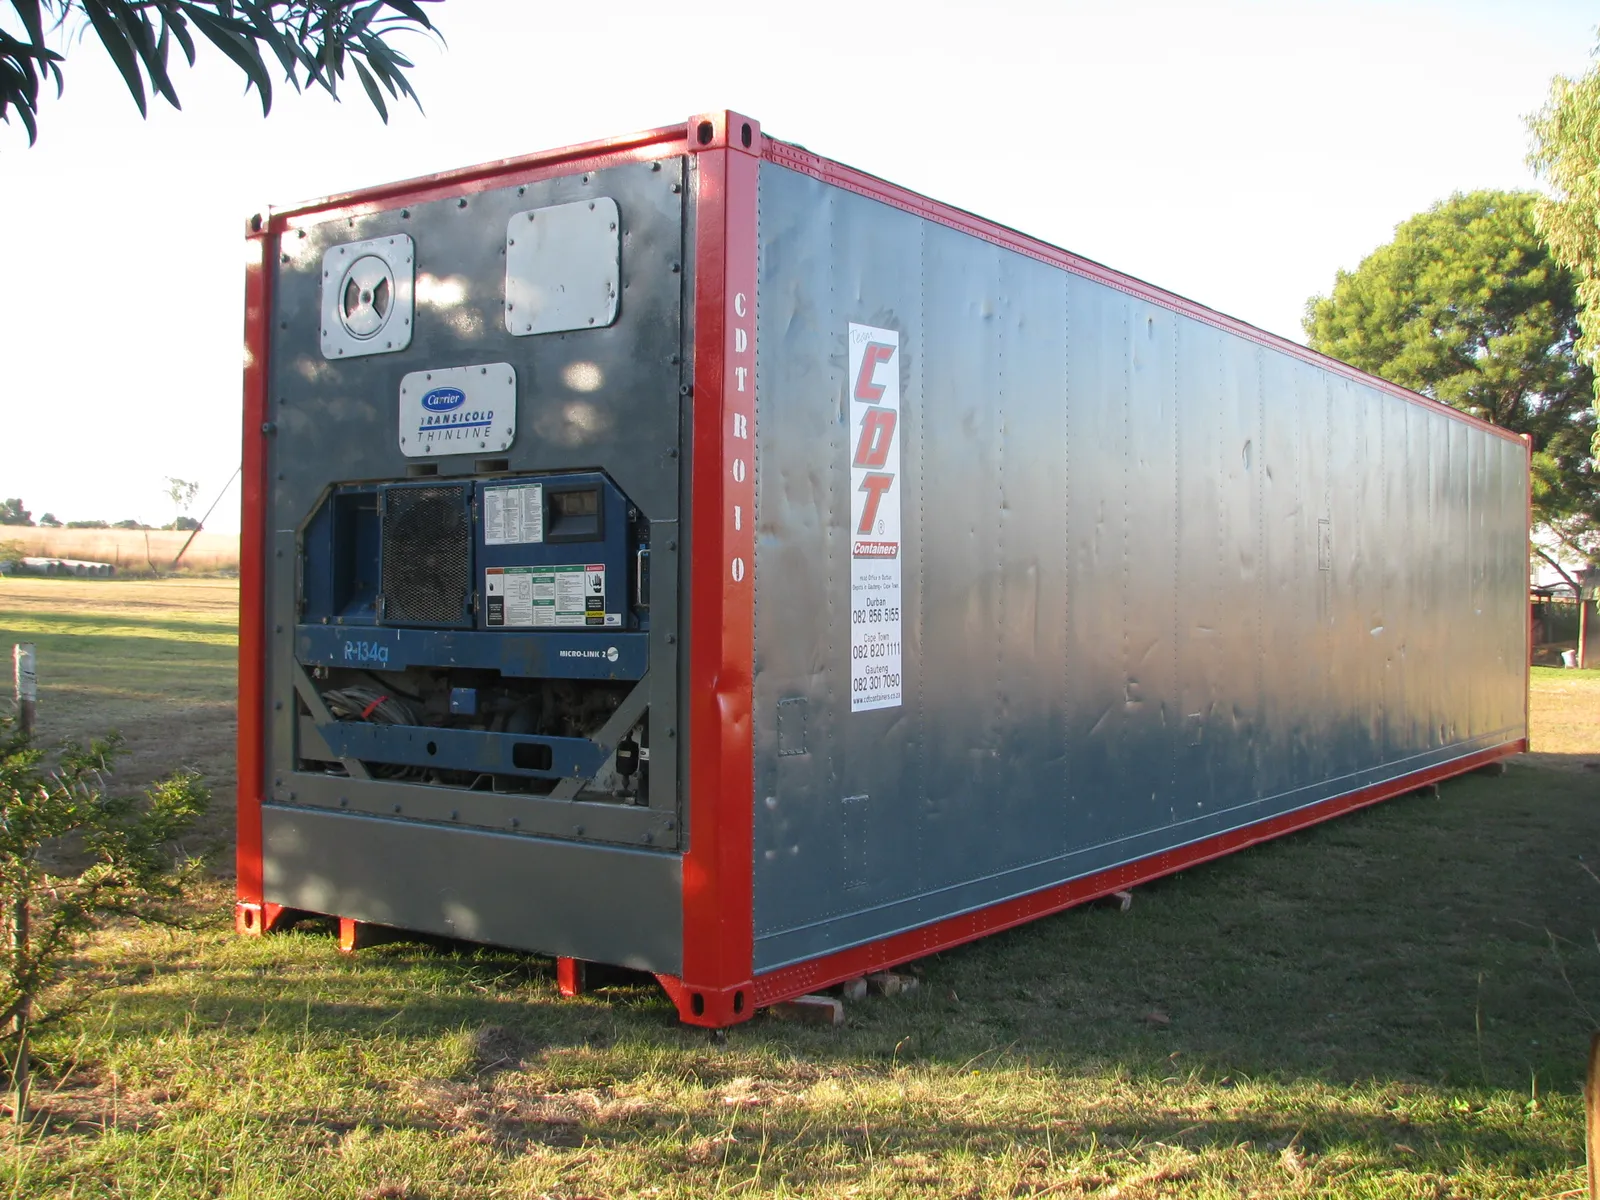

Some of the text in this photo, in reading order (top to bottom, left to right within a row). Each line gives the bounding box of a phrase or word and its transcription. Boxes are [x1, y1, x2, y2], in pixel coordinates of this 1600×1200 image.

[427, 394, 460, 406] Carrier
[420, 410, 494, 426] TRANSICOLD
[417, 426, 492, 442] THINLINE
[852, 341, 897, 535] CDT
[853, 541, 897, 555] Containers
[866, 597, 886, 607] Durban
[853, 609, 866, 624] 082
[868, 608, 882, 623] 856
[863, 632, 890, 643] Cape Town
[344, 640, 389, 662] R-134a
[559, 650, 600, 658] MICRO-LINK
[853, 641, 901, 659] 082 820 1111
[865, 664, 889, 674] Gauteng
[853, 672, 900, 692] 082 301 7090
